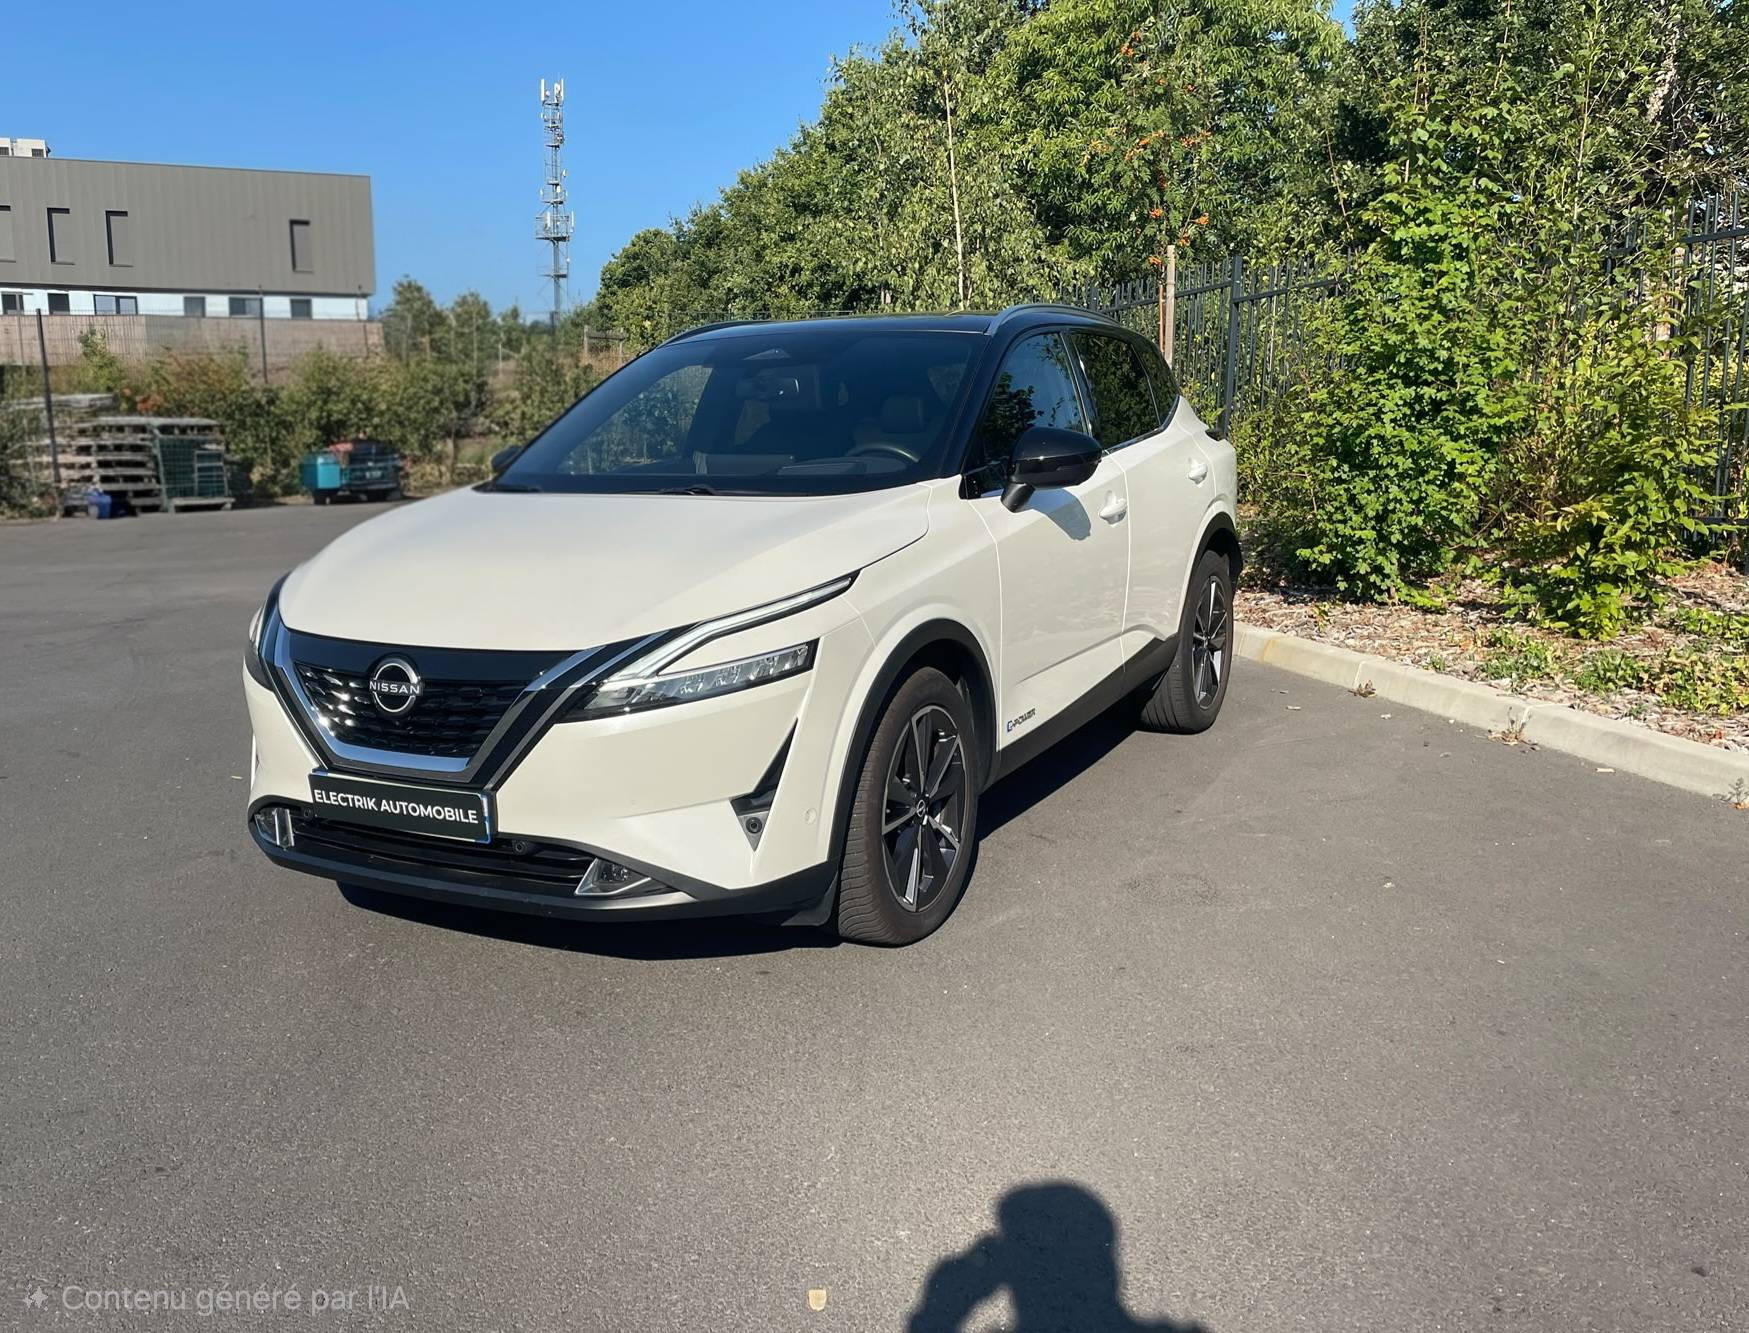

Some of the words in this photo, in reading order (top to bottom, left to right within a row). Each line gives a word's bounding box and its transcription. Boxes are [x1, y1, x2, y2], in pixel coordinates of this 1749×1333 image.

[369, 681, 420, 694] NISSAN
[314, 789, 378, 811] ELECTRIK
[380, 799, 478, 824] AUTOMOBILE
